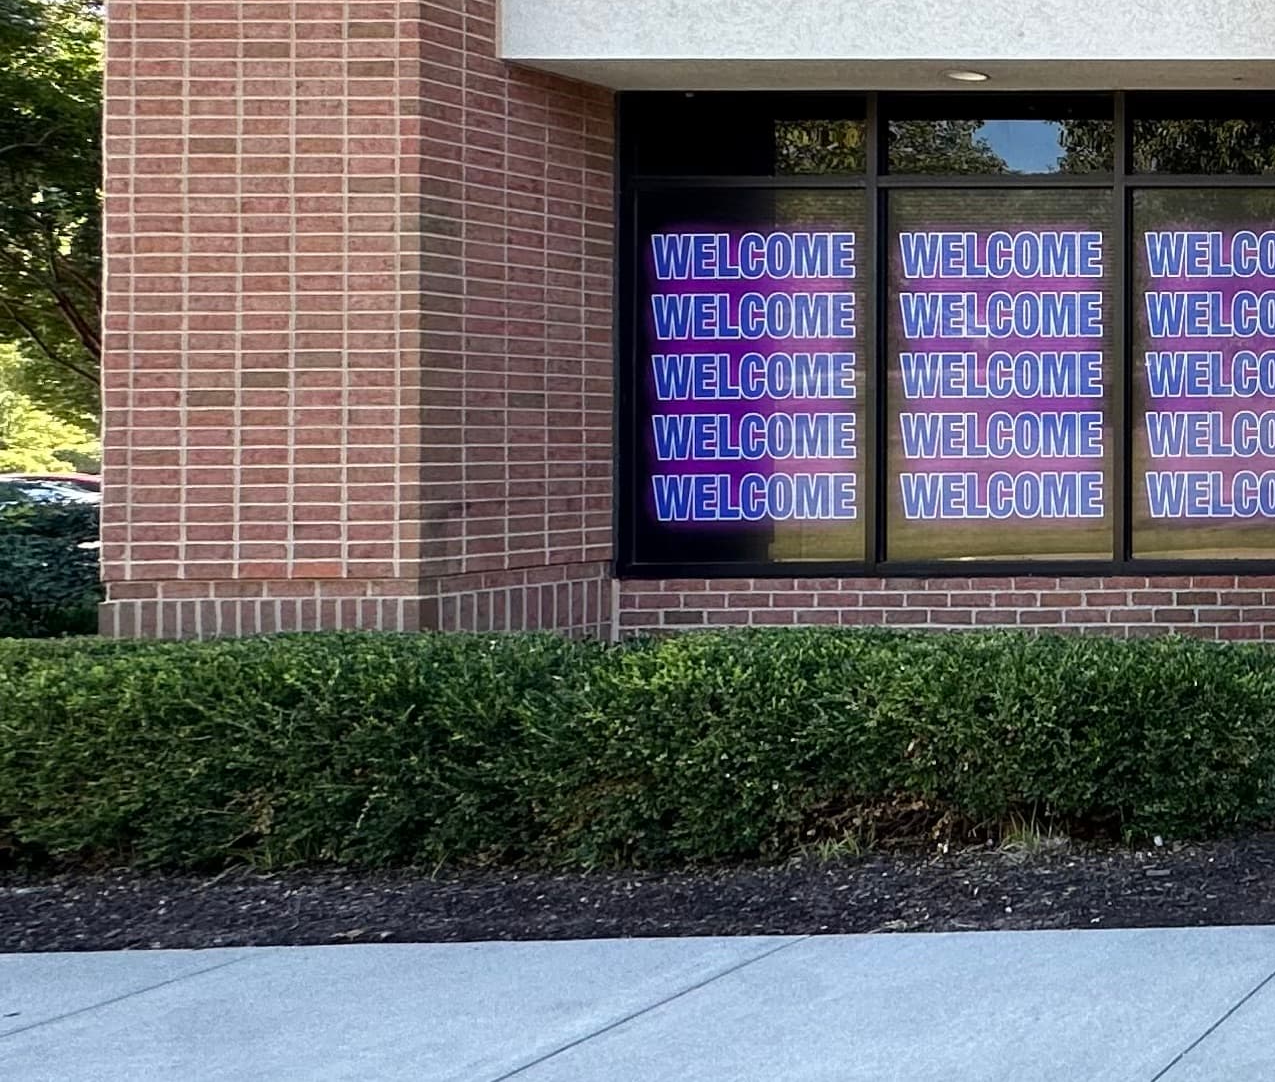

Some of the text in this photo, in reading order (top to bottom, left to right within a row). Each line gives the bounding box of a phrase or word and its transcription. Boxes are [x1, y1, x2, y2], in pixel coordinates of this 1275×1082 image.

[651, 232, 857, 281] WELCOME
[899, 231, 1103, 279] WELCOME
[651, 292, 857, 340] WELCOME
[899, 291, 1103, 339] WELCOME
[651, 353, 857, 400] WELCOME
[899, 351, 1103, 398] WELCOME
[651, 413, 857, 461] WELCOME
[899, 411, 1103, 459] WELCOME
[651, 472, 857, 521] WELCOME
[899, 471, 1103, 519] WELCOME
